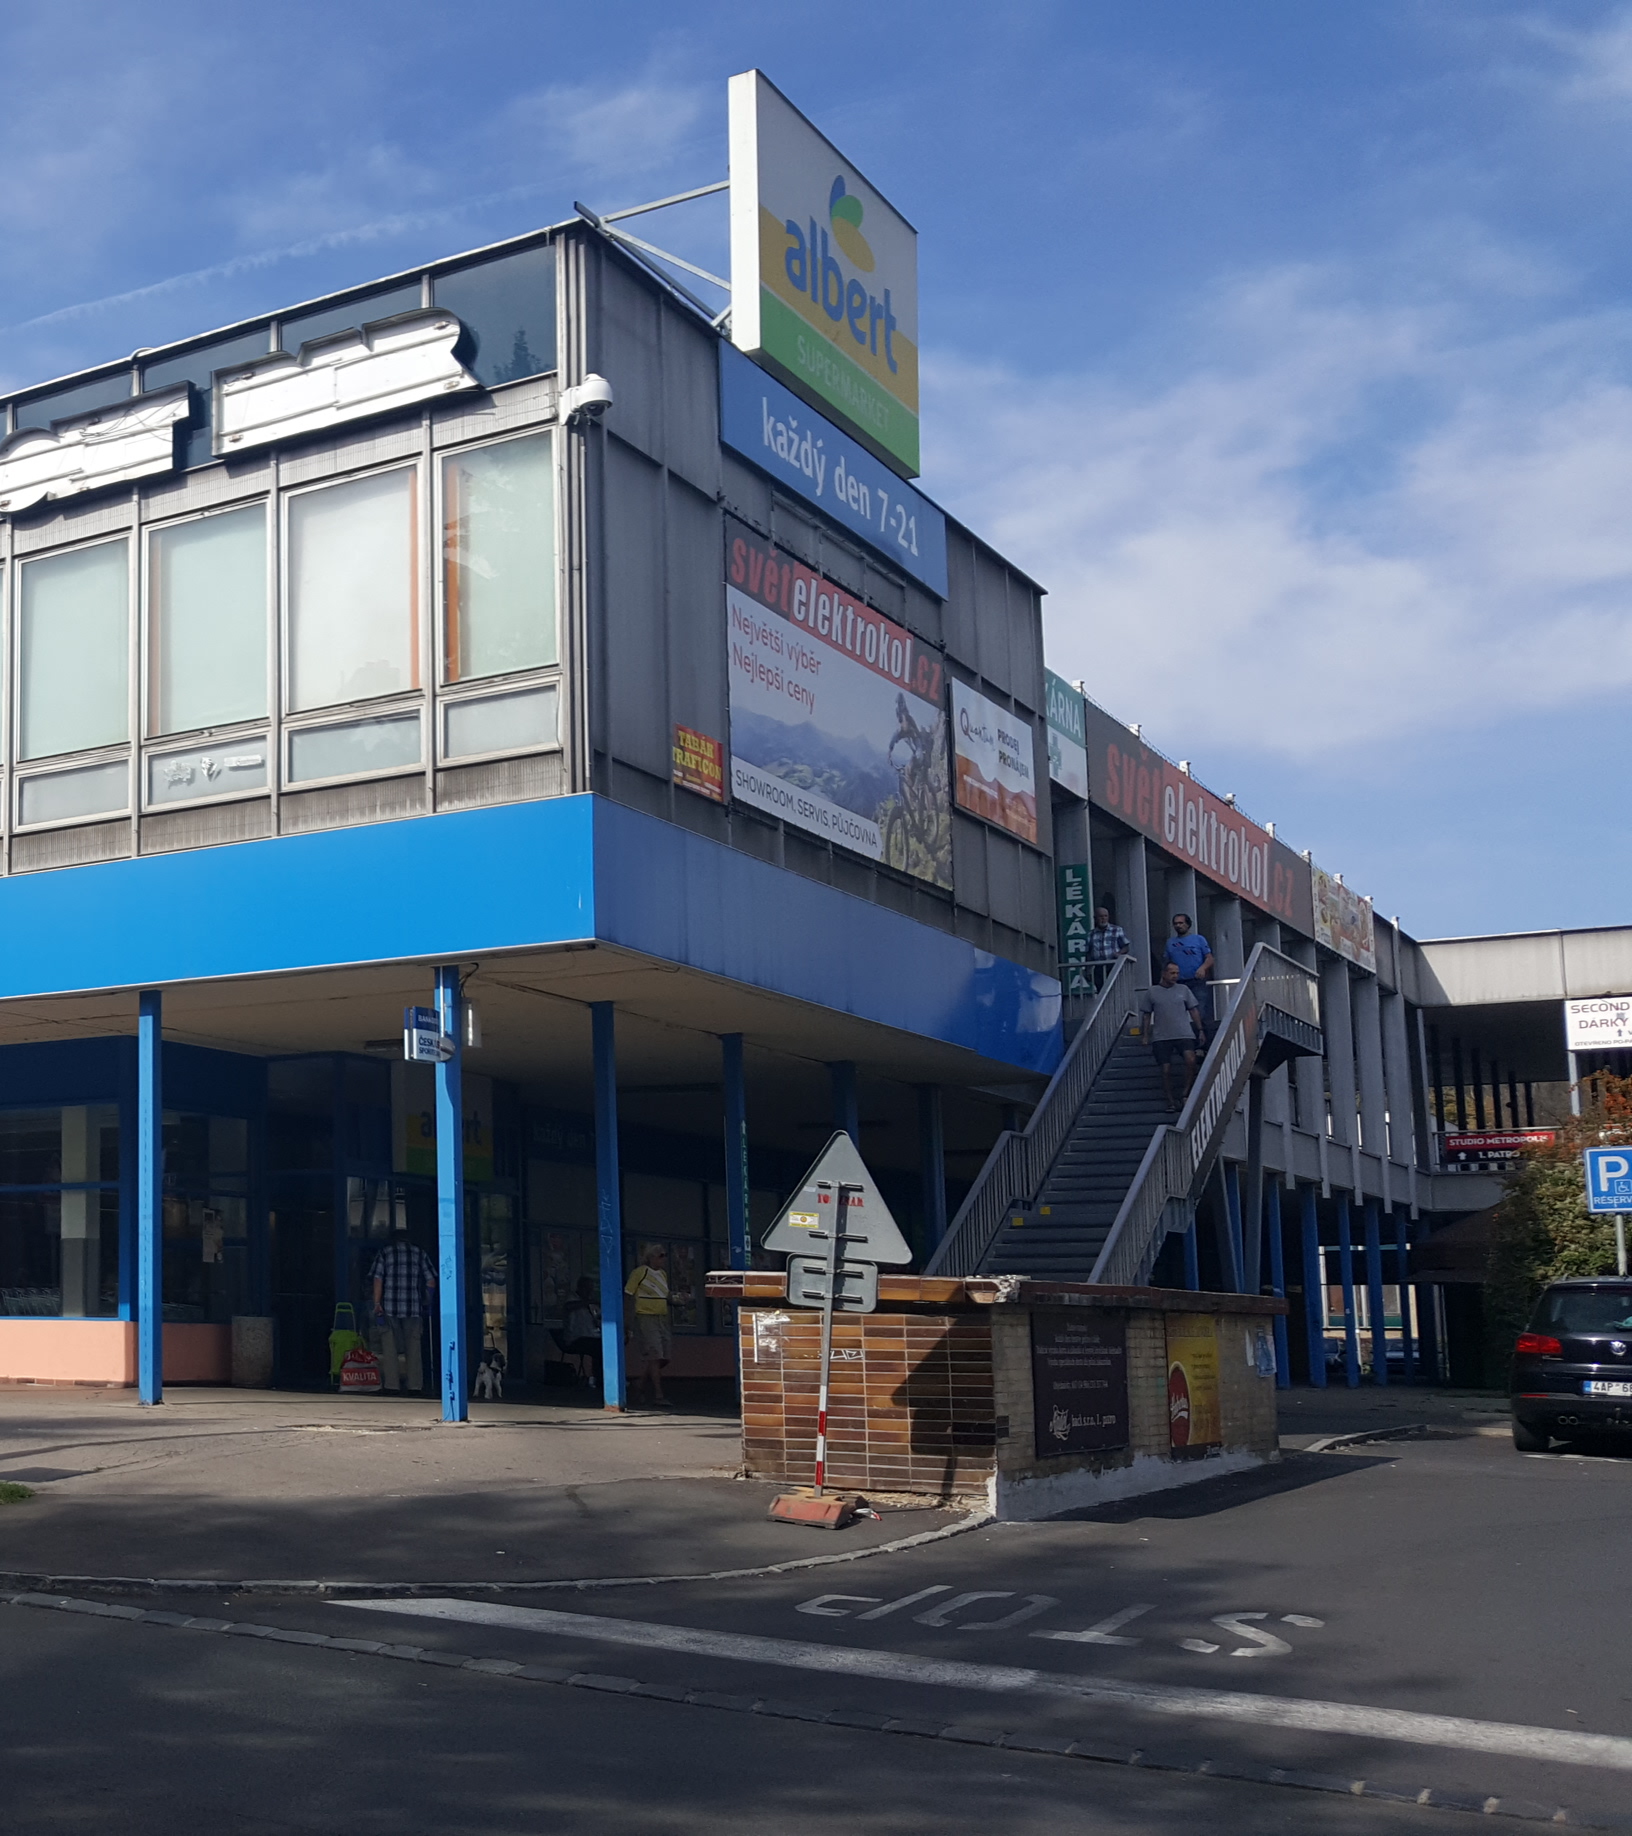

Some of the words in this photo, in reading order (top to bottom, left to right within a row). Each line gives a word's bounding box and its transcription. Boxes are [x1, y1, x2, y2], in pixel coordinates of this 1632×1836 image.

[784, 215, 898, 375] albert
[796, 334, 890, 433] SUPERMARKET
[762, 396, 826, 497] každý
[834, 455, 871, 520] den
[877, 488, 919, 557] 7-21
[786, 641, 822, 676] výběr
[787, 679, 815, 715] ceny
[1045, 678, 1081, 739] ÁRNA
[997, 728, 1020, 756] PRODEJ
[1570, 1001, 1631, 1014] SECOND
[1190, 1018, 1247, 1174] ELEKTROKOLA
[1448, 1136, 1484, 1146] STUDIO
[1598, 1156, 1629, 1192] P
[342, 1371, 377, 1382] KVALITA
[1593, 1382, 1614, 1392] 4AP
[793, 1584, 1326, 1658] STOP
